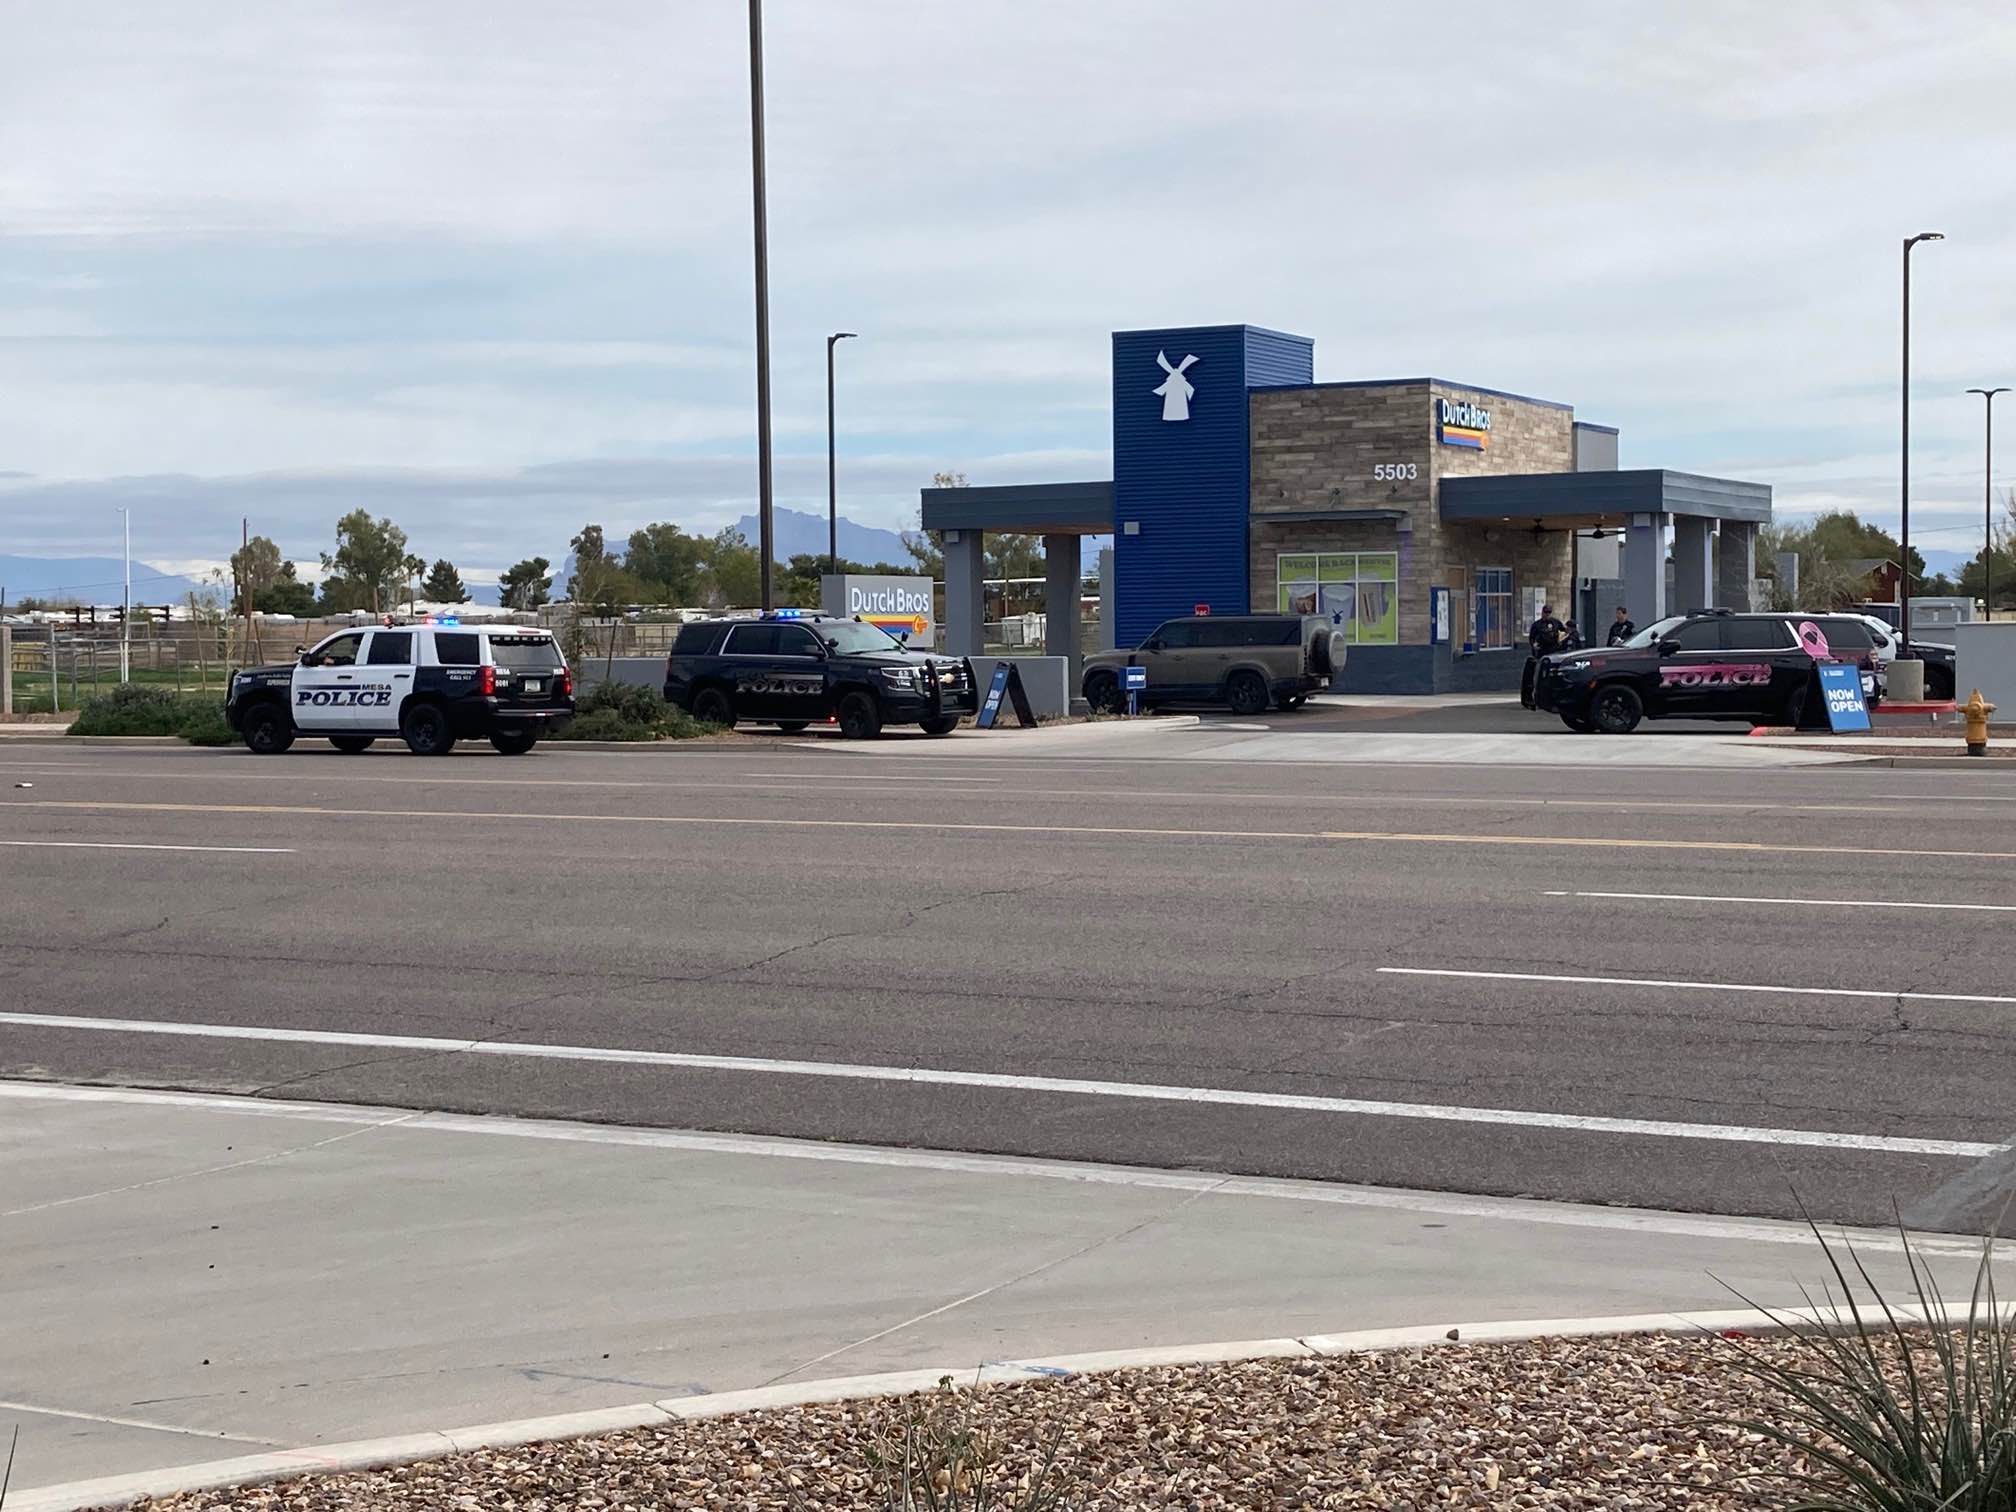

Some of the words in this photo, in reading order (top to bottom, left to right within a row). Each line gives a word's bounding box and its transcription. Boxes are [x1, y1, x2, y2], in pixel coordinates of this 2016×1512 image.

[1374, 463, 1418, 480] 5503
[851, 587, 895, 613] DUTCH
[897, 588, 929, 613] BROS
[736, 679, 823, 694] POLICE
[1659, 672, 1772, 688] POLICE
[296, 691, 392, 706] POLICE
[1828, 689, 1854, 700] NOW
[1830, 700, 1864, 713] OPEN
